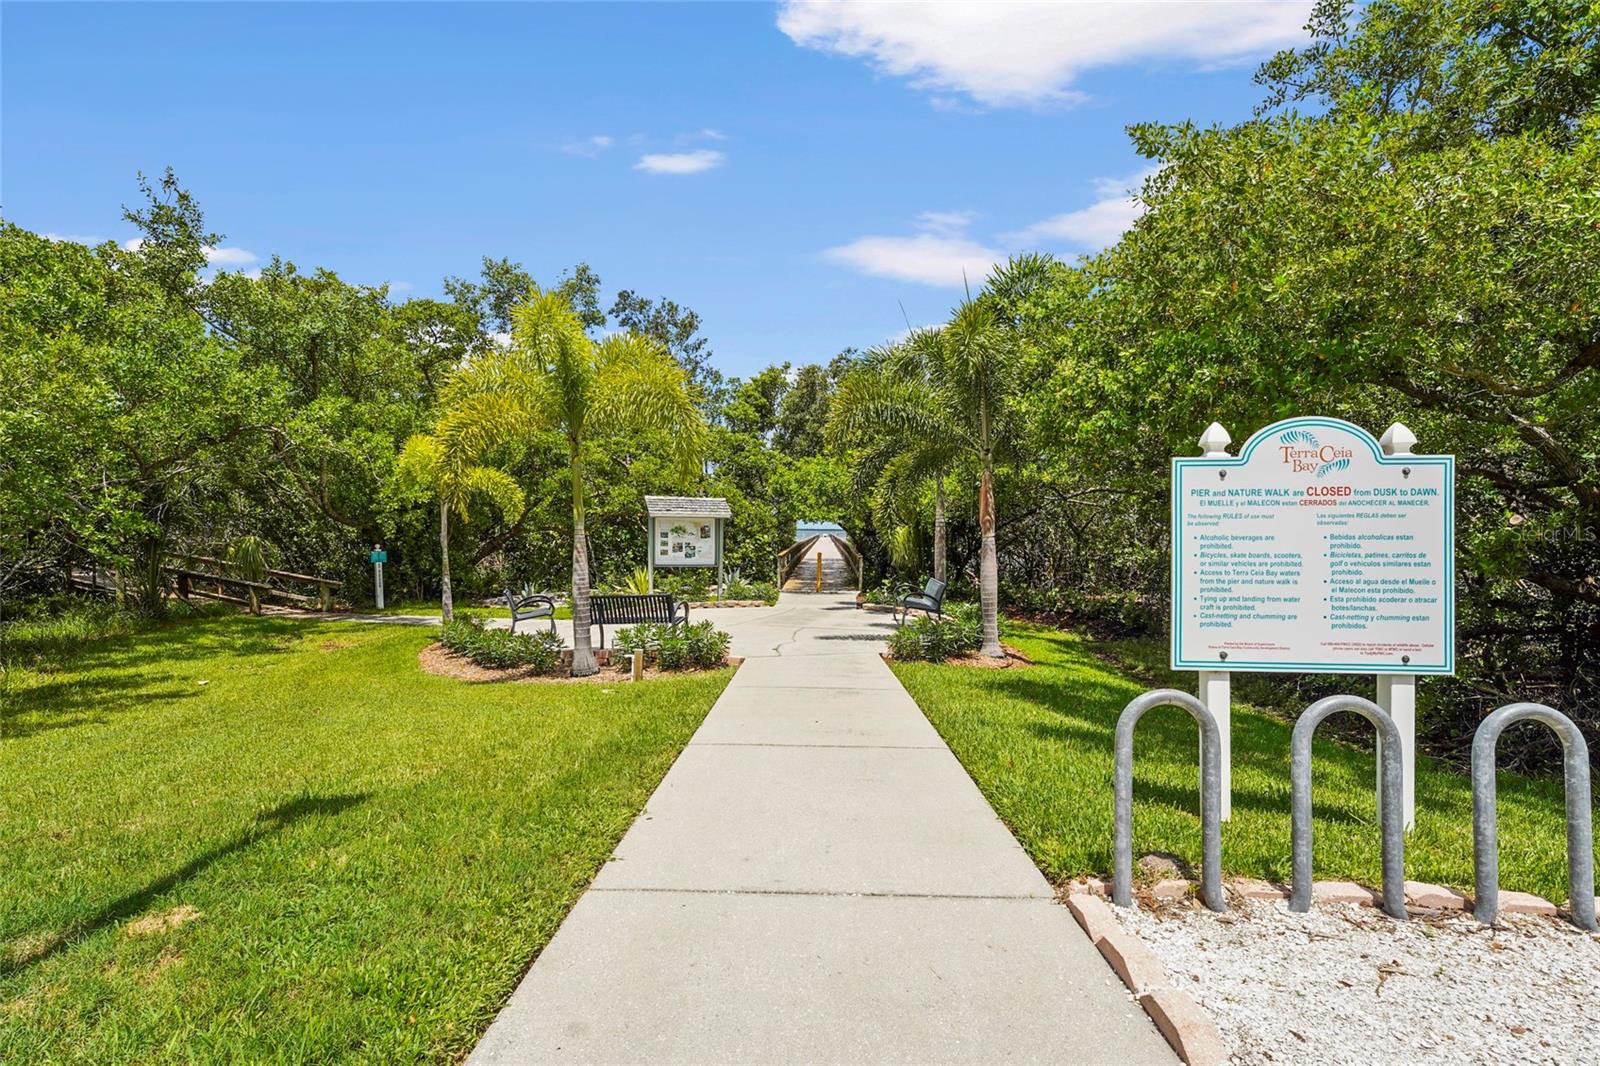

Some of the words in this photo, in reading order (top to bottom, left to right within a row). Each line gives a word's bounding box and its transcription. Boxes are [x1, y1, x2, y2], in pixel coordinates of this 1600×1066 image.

[1279, 446, 1318, 463] Terra
[1320, 446, 1353, 462] Ceia
[1293, 460, 1319, 473] Bay
[1306, 487, 1351, 496] CLOSED
[1374, 488, 1397, 496] DUSK
[1410, 488, 1439, 496] DAWN.
[1227, 578, 1239, 586] pier
